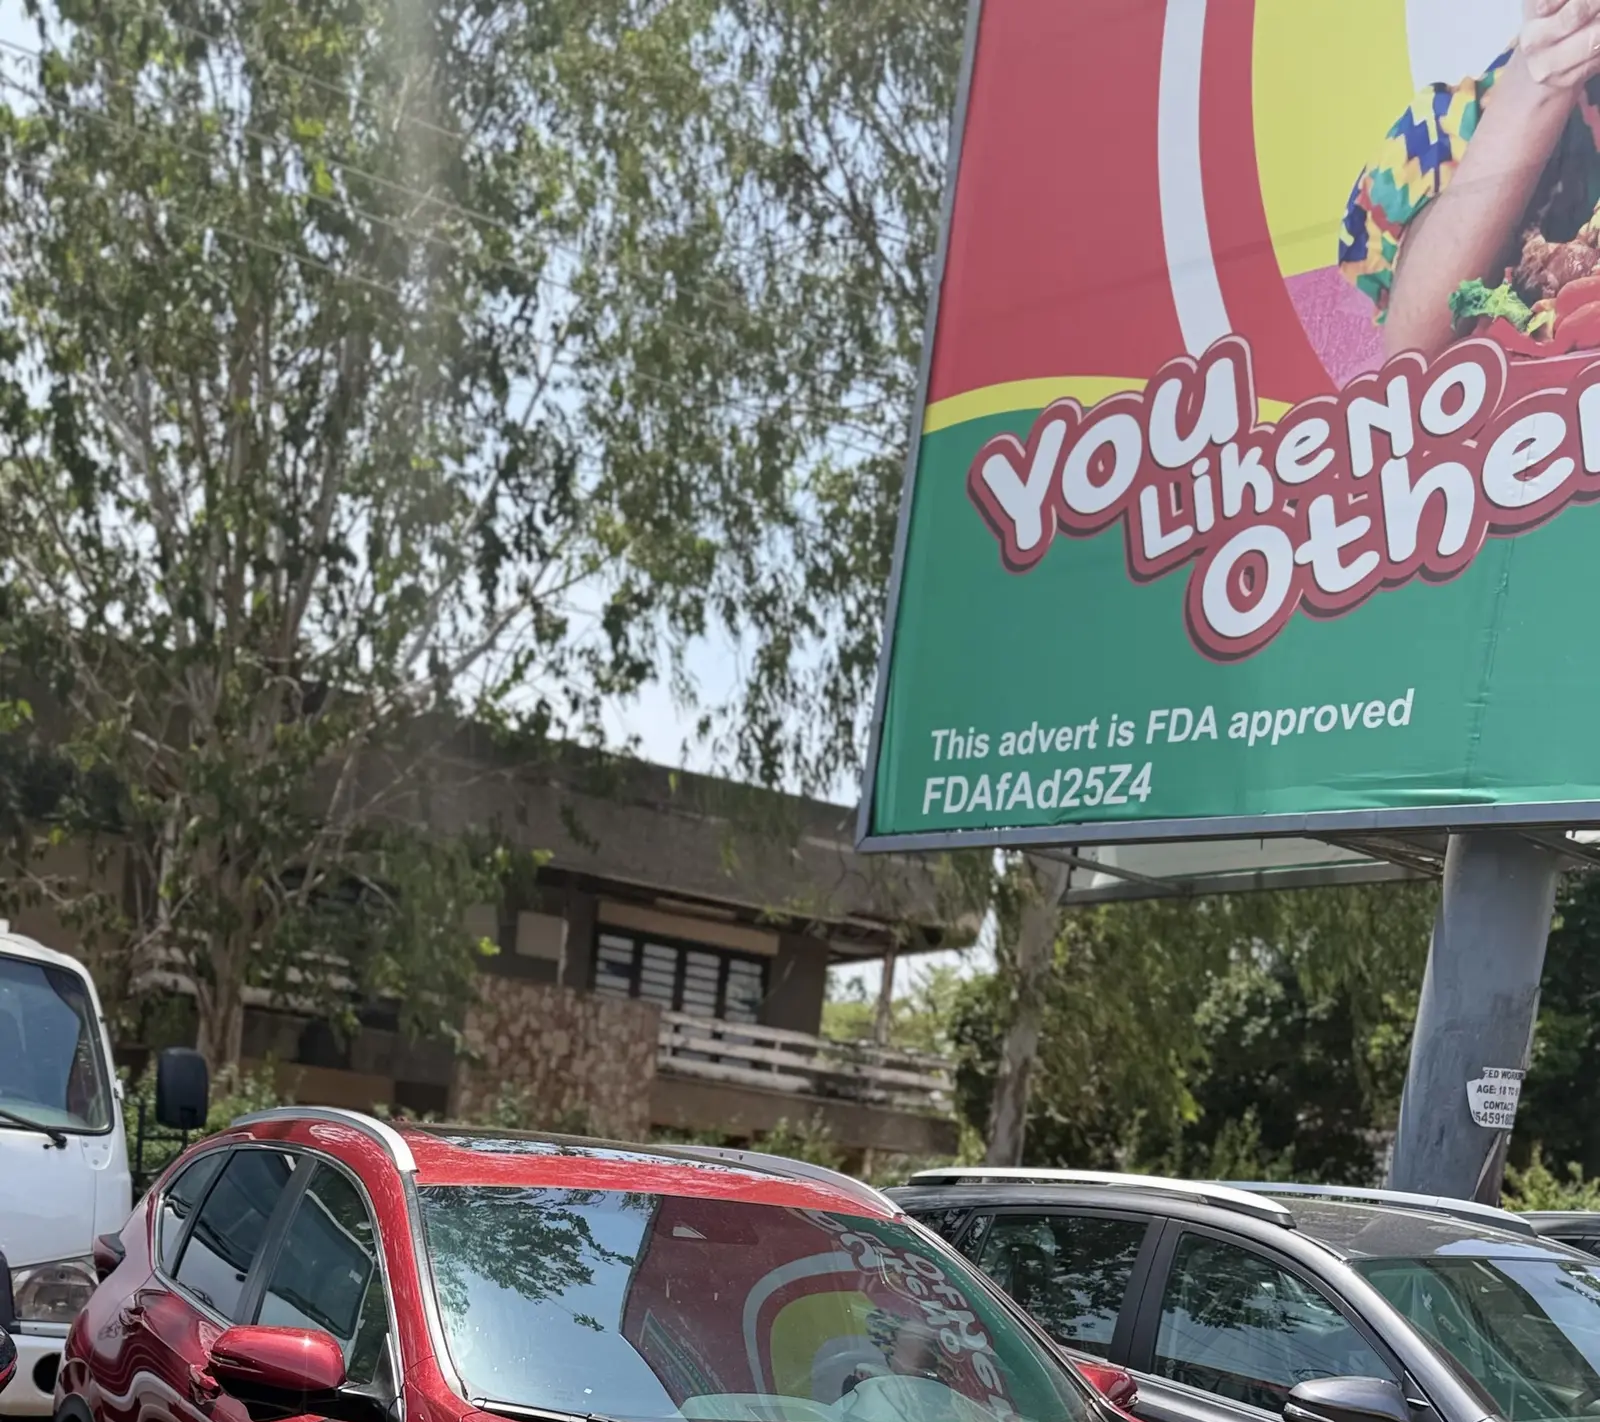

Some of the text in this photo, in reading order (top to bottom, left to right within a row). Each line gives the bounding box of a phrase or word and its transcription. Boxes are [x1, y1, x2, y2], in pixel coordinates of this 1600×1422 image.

[931, 688, 1415, 760] This advert is FDA approved
[921, 762, 1154, 814] FDAfAd25Z4
